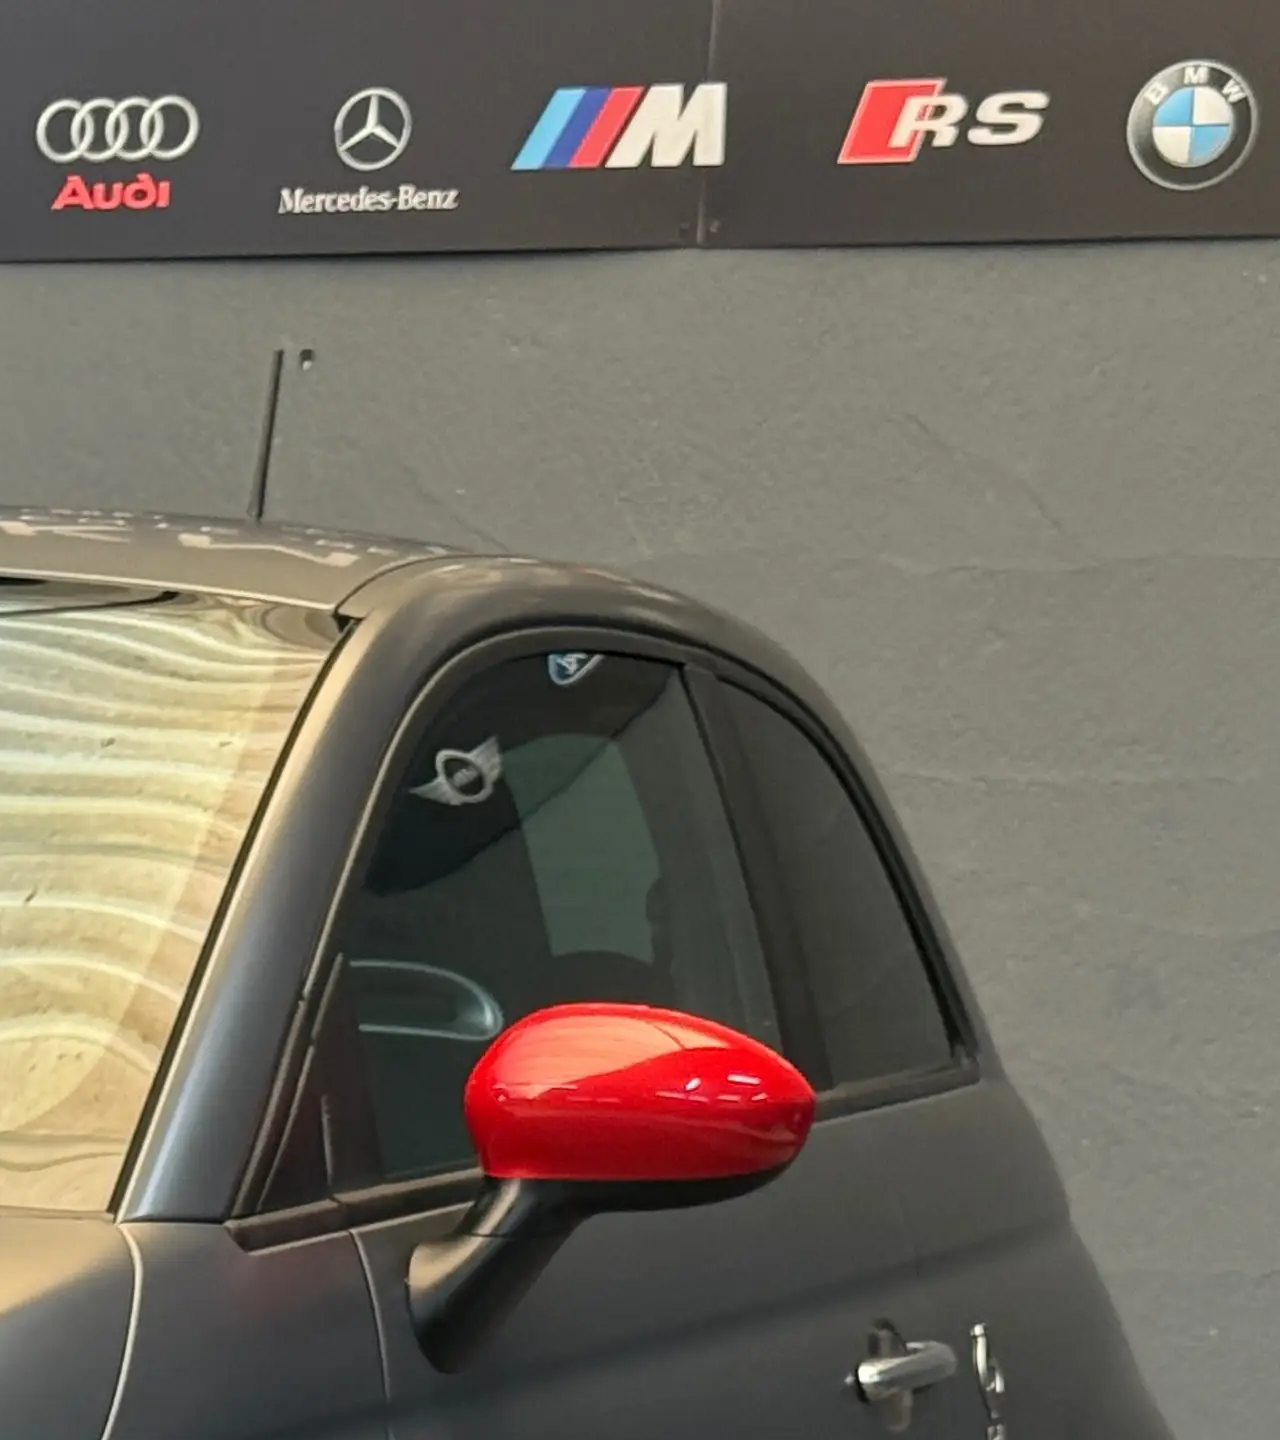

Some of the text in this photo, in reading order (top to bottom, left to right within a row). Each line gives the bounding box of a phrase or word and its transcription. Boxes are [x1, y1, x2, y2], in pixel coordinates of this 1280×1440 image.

[1143, 66, 1247, 105] BMW
[888, 91, 1050, 147] RS
[53, 172, 171, 211] Audi
[277, 184, 460, 215] Mercedes-Benz
